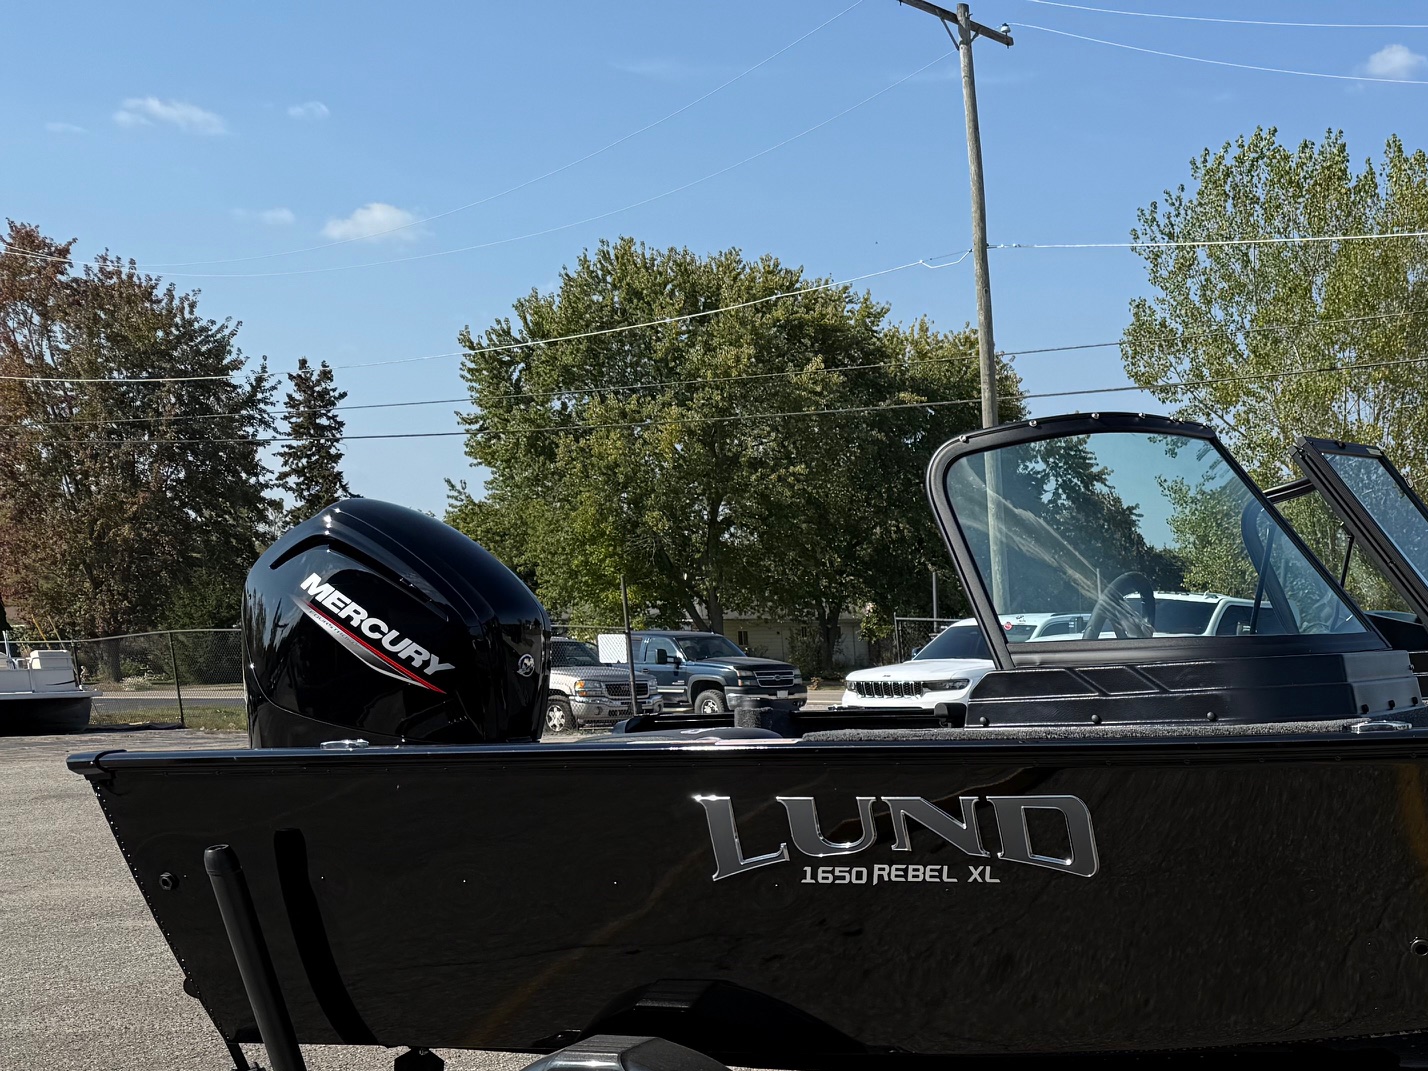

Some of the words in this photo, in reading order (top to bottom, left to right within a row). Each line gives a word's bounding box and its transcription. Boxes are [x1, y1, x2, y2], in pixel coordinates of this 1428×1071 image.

[300, 572, 456, 676] MERCURY
[693, 794, 1100, 882] LUND
[800, 866, 868, 884] 1650
[872, 863, 959, 886] REBEL
[967, 865, 1001, 884] XL
